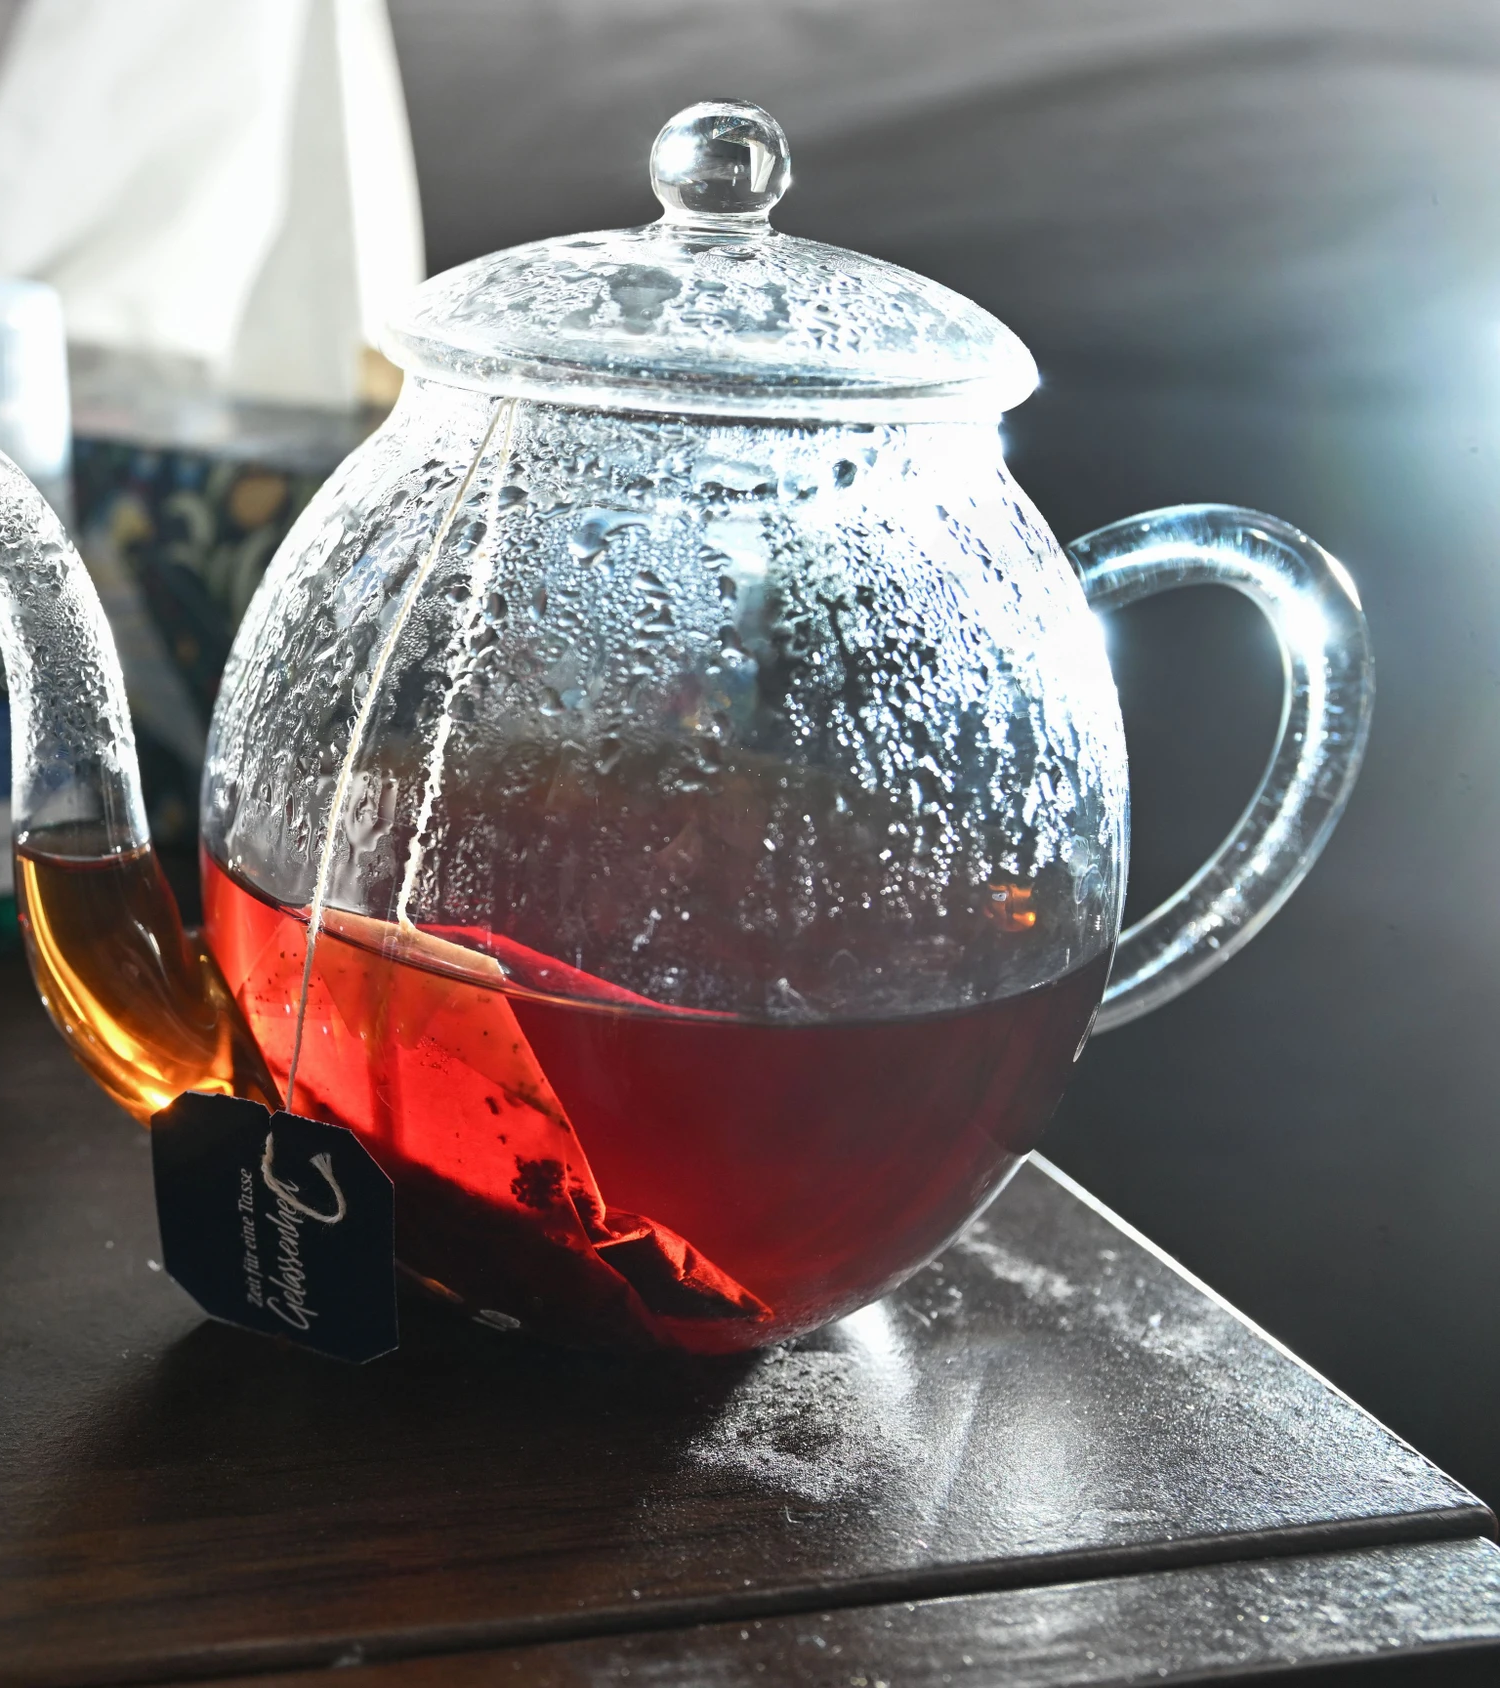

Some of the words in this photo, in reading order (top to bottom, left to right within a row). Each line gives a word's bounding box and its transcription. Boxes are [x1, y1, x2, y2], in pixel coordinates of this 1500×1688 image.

[238, 1168, 254, 1214] Tasse
[240, 1217, 257, 1250] eine
[243, 1250, 263, 1277] für
[266, 1178, 319, 1330] Gelassenhet
[246, 1277, 263, 1308] Zeit
